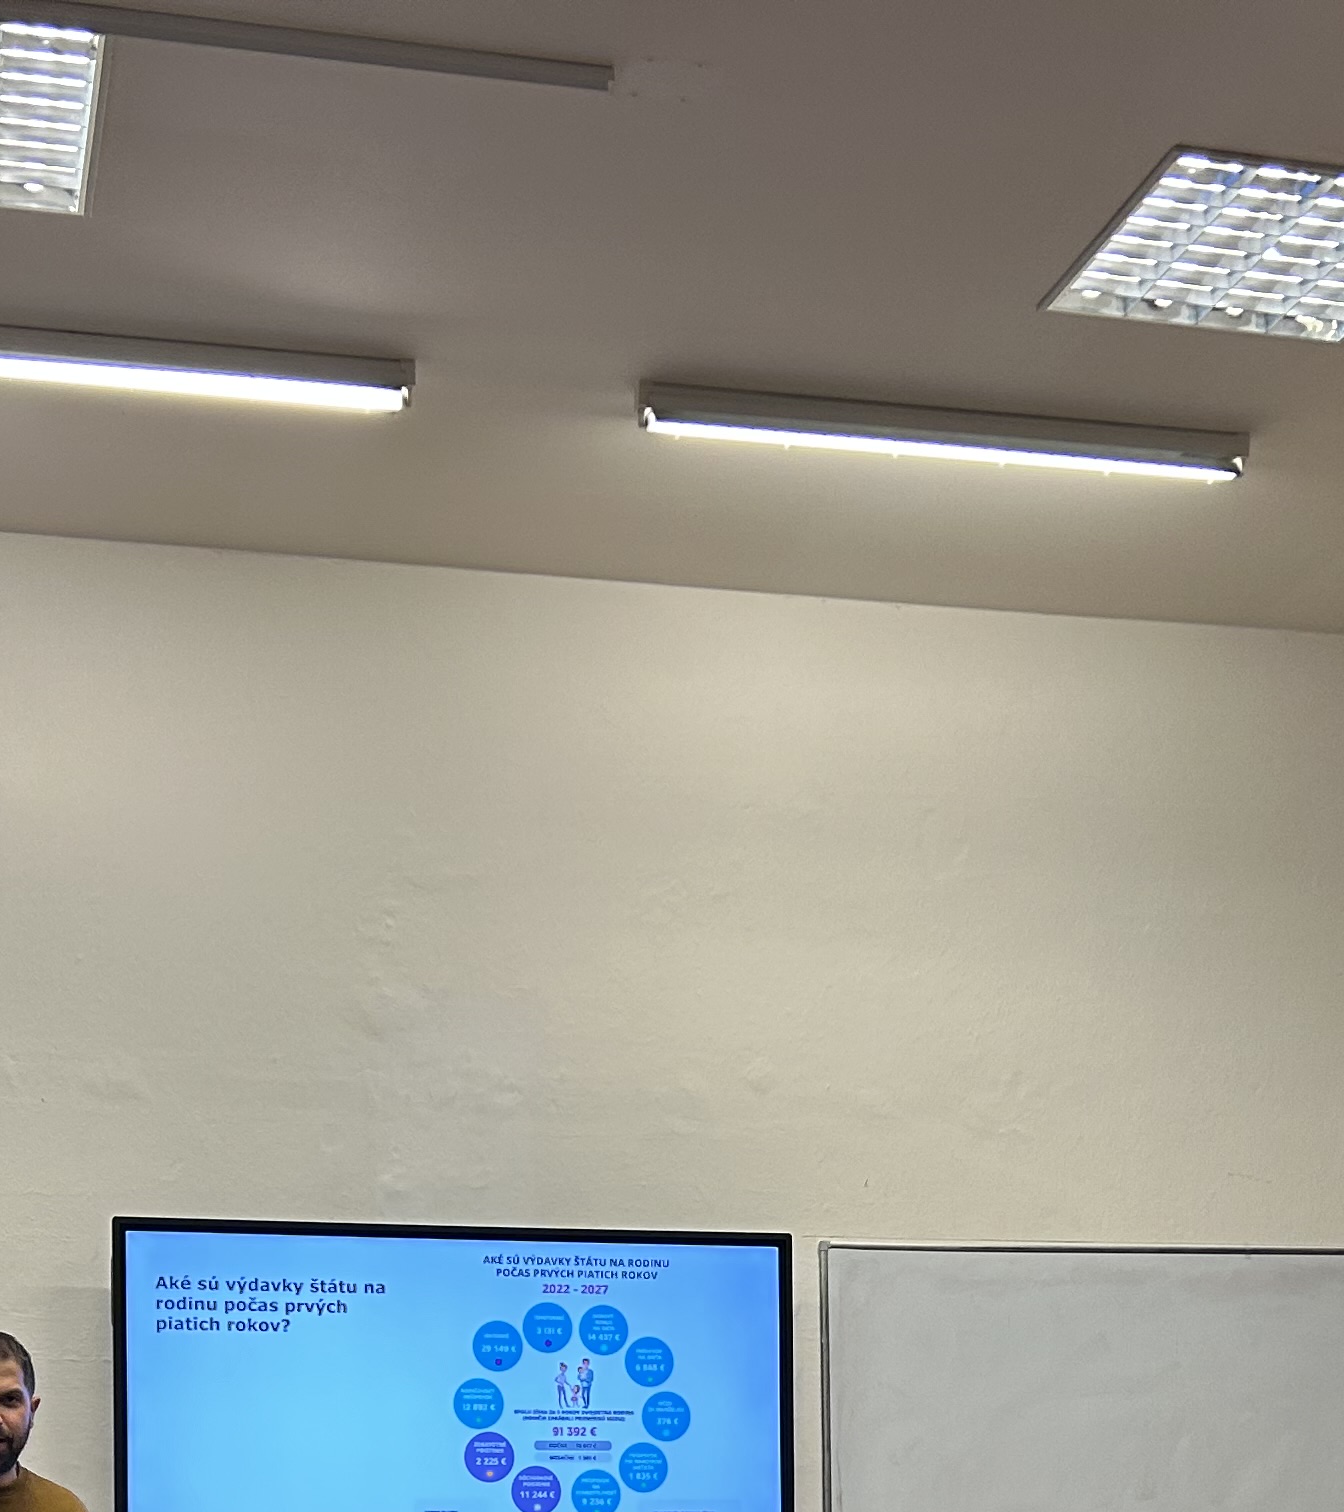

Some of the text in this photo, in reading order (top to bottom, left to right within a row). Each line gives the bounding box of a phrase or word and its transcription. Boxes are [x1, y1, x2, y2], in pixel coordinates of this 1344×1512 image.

[483, 1254, 670, 1268] AKÉ SÚ VÝDAVKY ŠTÁTU NA RODINU
[496, 1267, 659, 1280] POČAS PRVÝCH PIATICH ROKOV
[156, 1275, 386, 1295] Aké sú výdavky štátu na
[542, 1284, 571, 1294] 2022
[581, 1284, 609, 1295] 2027
[156, 1296, 348, 1316] rodinu počas prvých
[156, 1317, 291, 1333] piatich rokov?
[552, 1426, 598, 1437] 91 392 €
